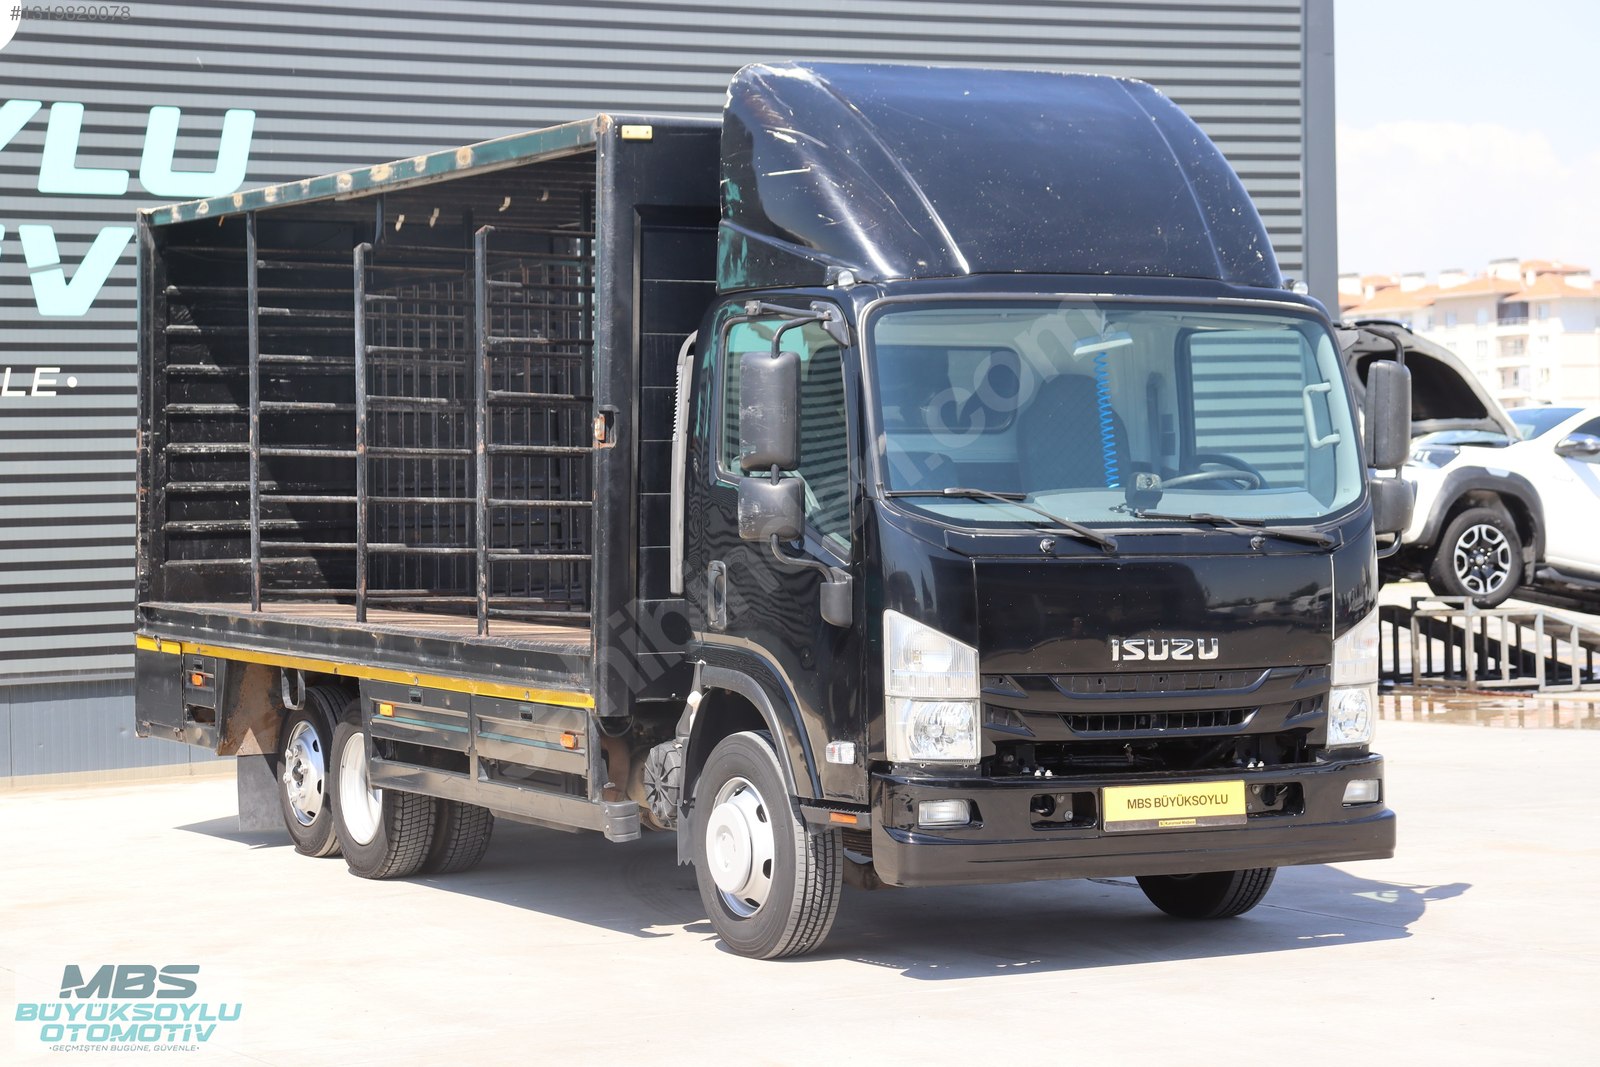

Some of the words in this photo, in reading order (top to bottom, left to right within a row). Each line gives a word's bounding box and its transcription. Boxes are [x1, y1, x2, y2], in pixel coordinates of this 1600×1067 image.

[1110, 637, 1219, 662] ISUZU
[1127, 796, 1152, 810] MBS
[1154, 794, 1228, 808] BÜYÜKSOYLU
